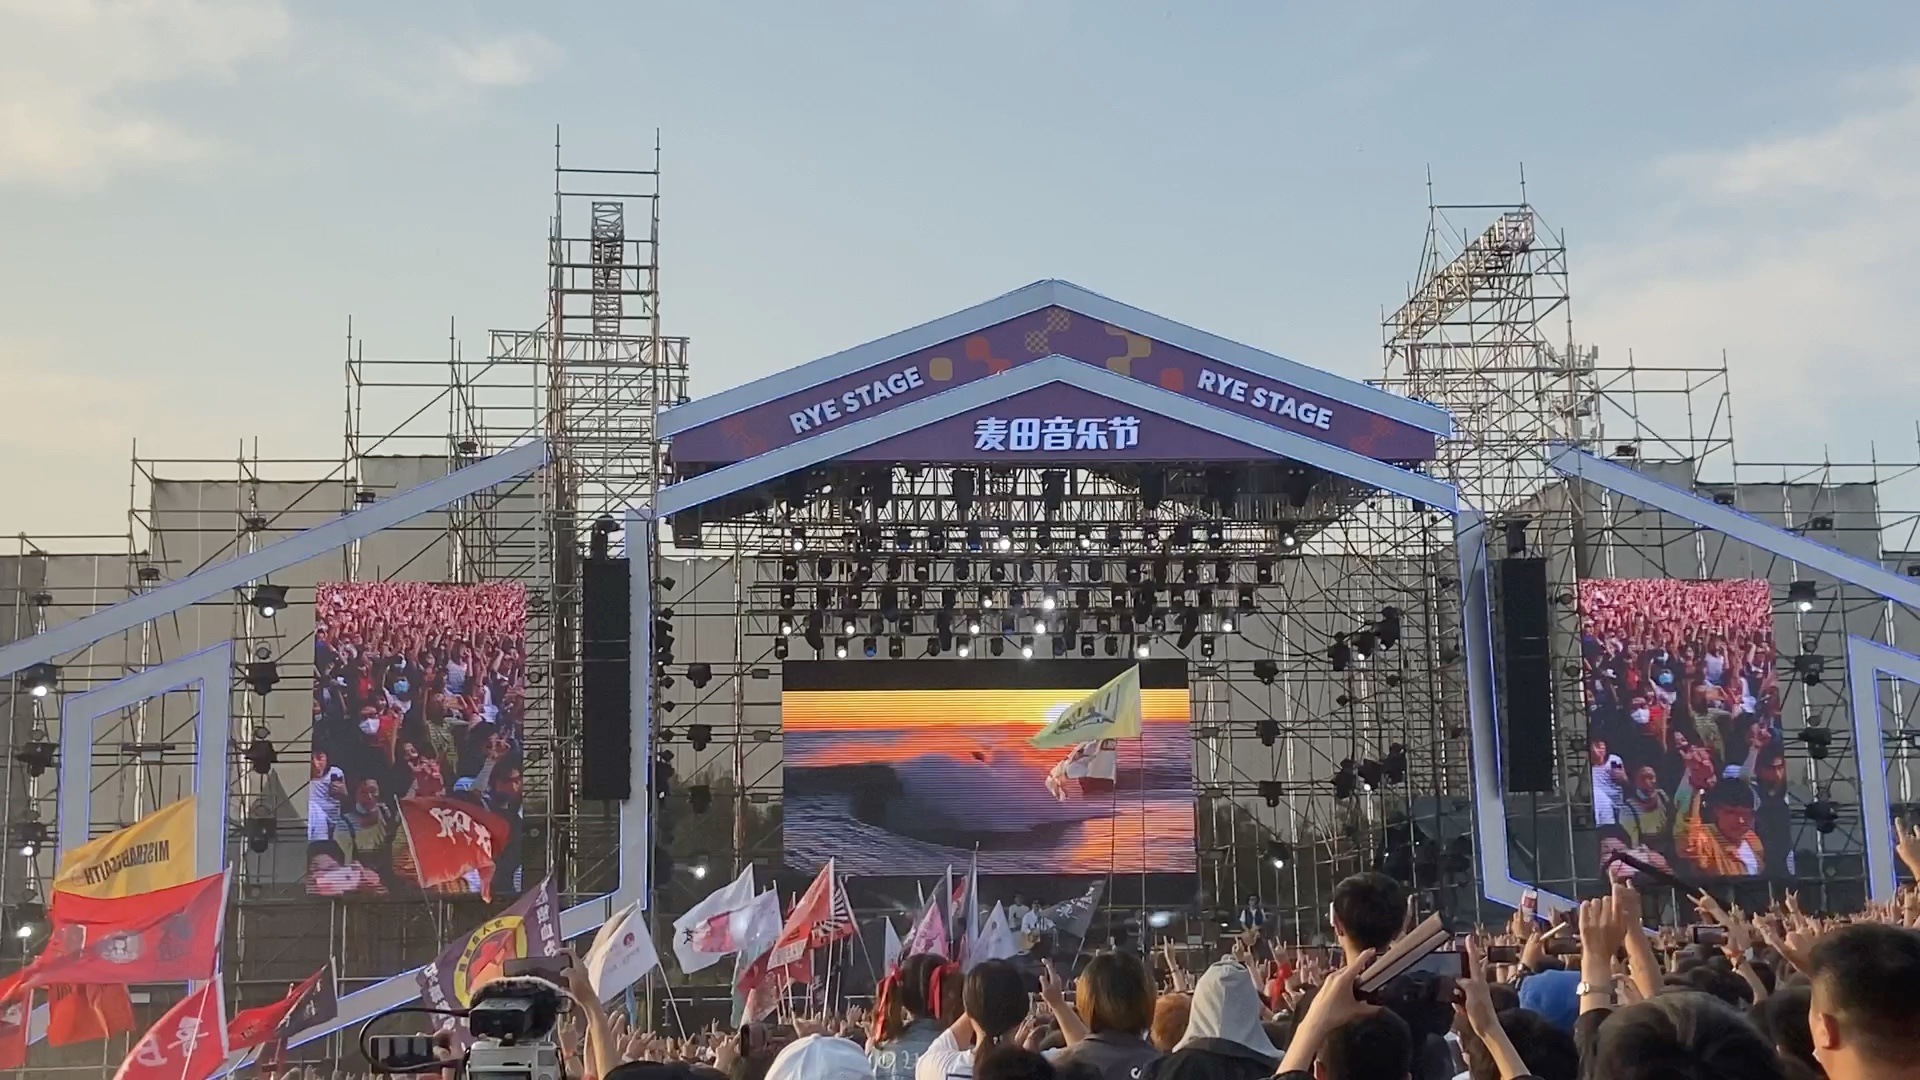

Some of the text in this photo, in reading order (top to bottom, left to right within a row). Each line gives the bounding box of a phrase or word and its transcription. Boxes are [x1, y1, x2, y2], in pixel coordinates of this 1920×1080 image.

[789, 366, 925, 434] RYE STAGE
[1197, 368, 1334, 430] RYE STAGE
[974, 416, 1141, 451] 麦田音乐节
